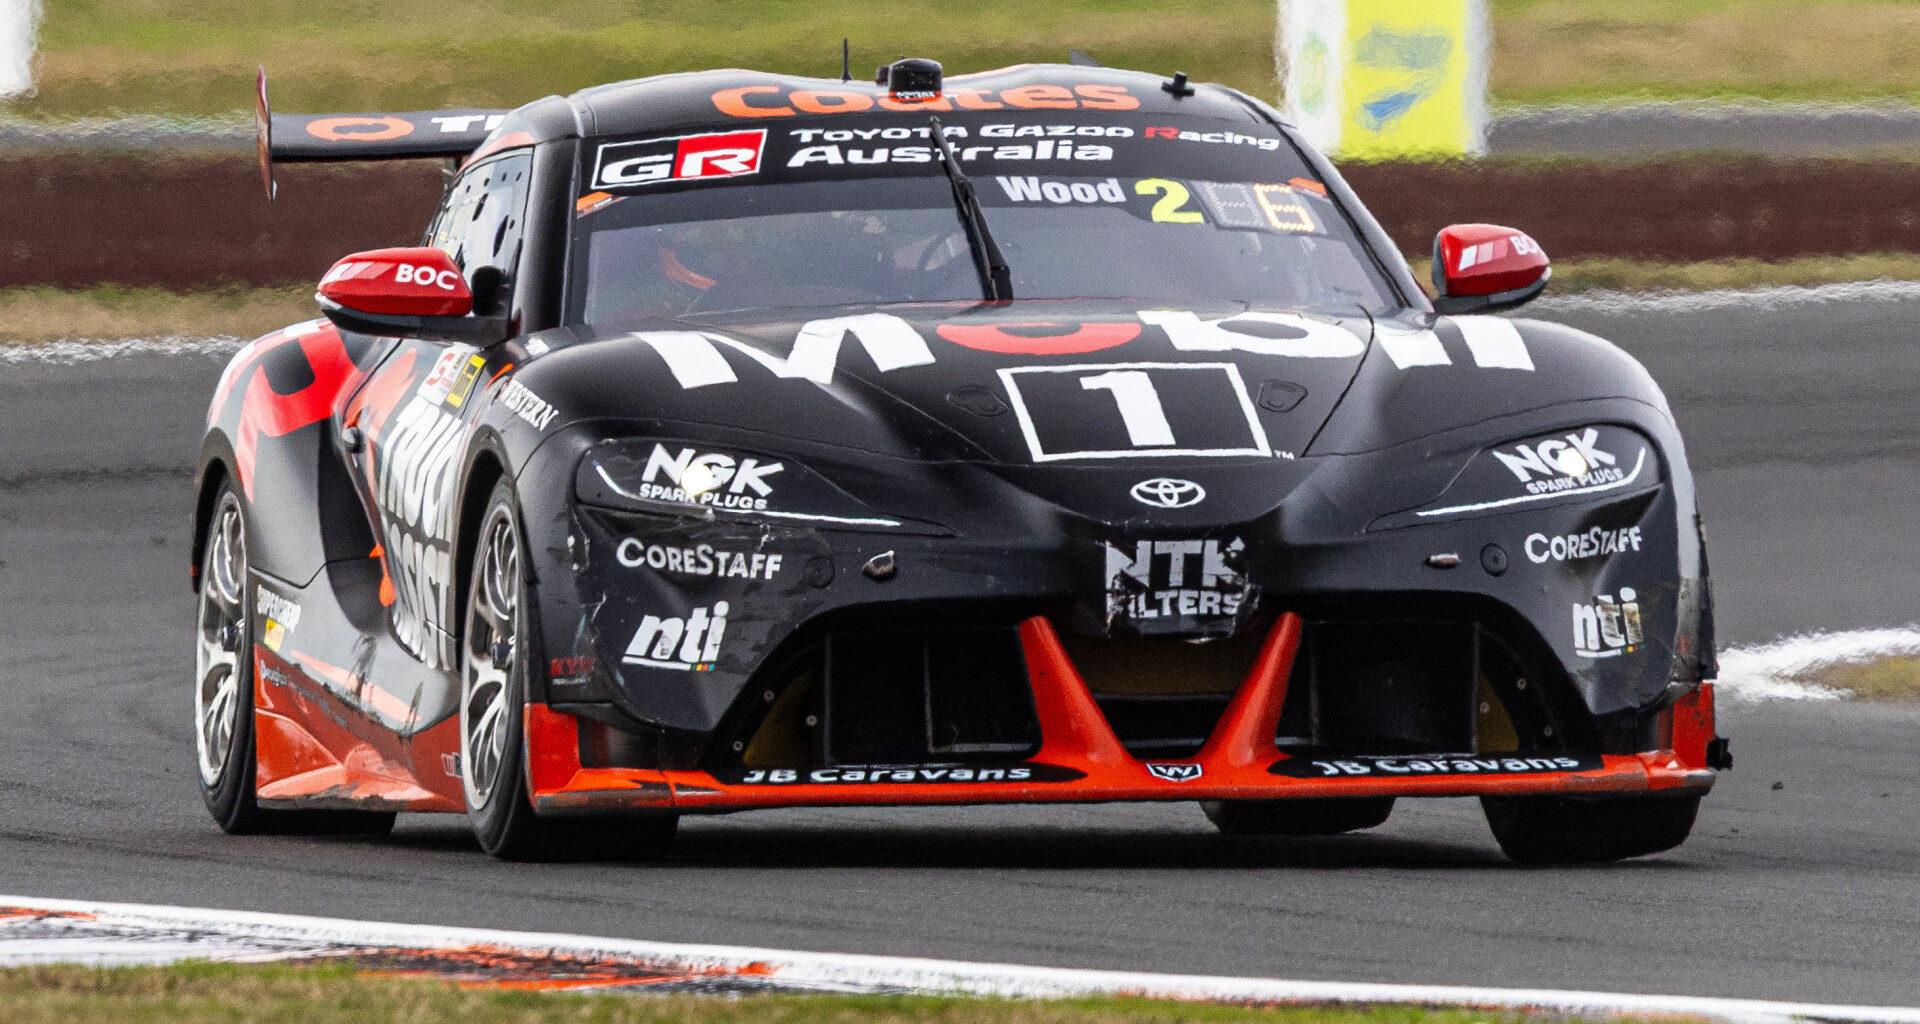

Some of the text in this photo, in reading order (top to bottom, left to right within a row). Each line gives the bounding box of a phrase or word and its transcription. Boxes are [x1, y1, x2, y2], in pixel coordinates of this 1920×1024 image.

[711, 84, 1141, 118] Coates
[787, 140, 1114, 167] Australia
[789, 124, 1280, 151] TOYOTA GAZOO Racing
[600, 145, 757, 184] GR
[996, 176, 1205, 223] Wood 2
[395, 263, 459, 291] BOC
[632, 309, 1536, 389] Mobil
[1079, 371, 1177, 447] 1
[642, 443, 785, 498] NGK
[1493, 428, 1616, 483] NGK
[640, 483, 768, 510] SPARK PLUGS
[1526, 467, 1624, 494] SPARK PLUGS
[625, 601, 730, 662] nti
[1573, 587, 1644, 650] nti
[743, 768, 1031, 783] JB Caravans
[1312, 757, 1580, 775] JB Caravans
